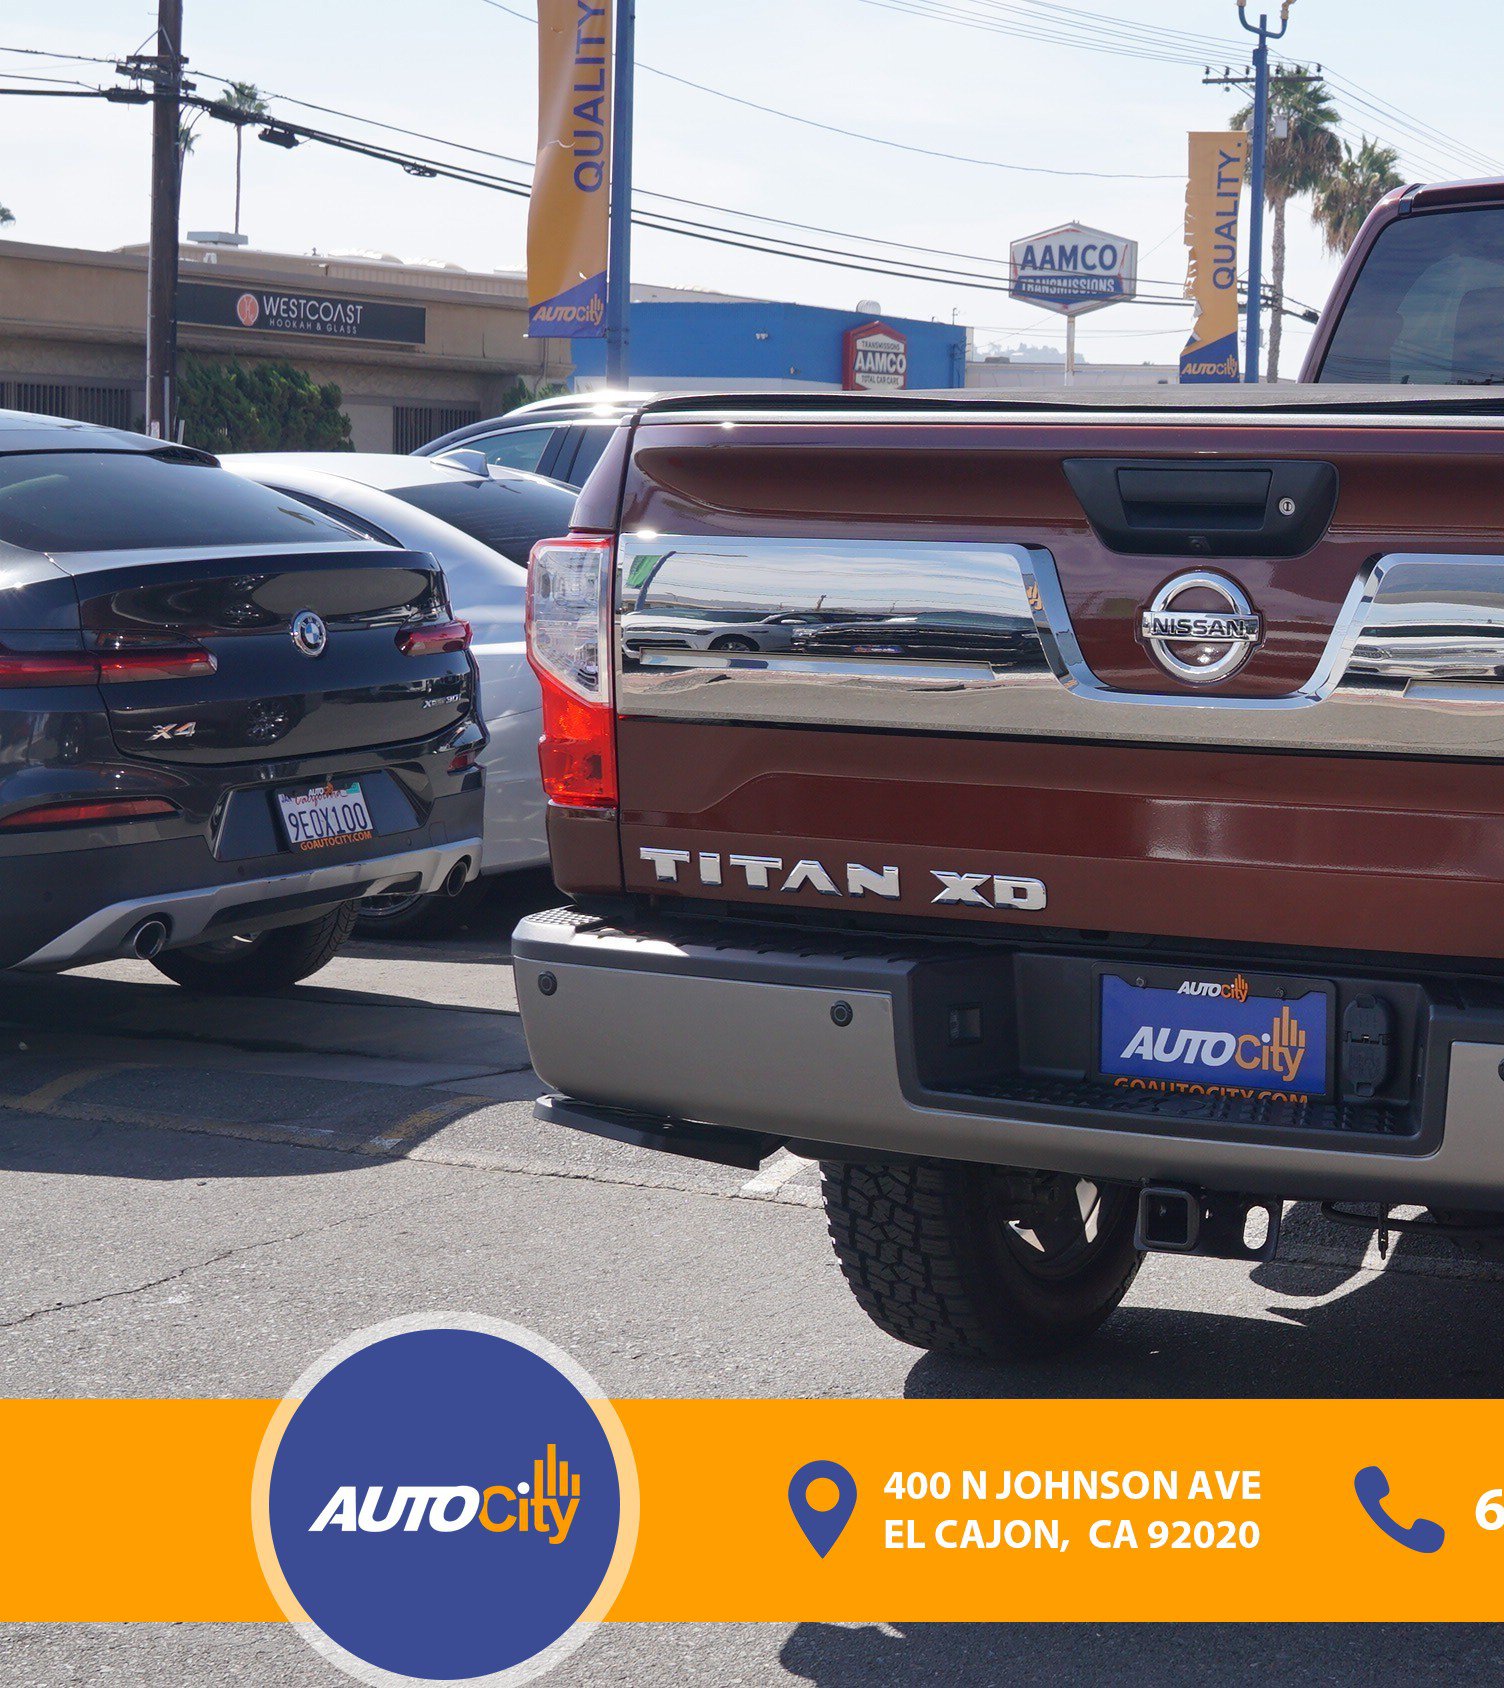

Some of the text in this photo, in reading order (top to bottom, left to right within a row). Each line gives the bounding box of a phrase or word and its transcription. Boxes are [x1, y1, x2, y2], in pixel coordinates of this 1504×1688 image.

[573, 0, 605, 193] QUALITY
[1020, 244, 1117, 271] AAMCO
[1020, 278, 1115, 295] TRANSMISSIONS
[263, 295, 363, 324] WESTCOAST
[269, 318, 358, 335] HOOKAH & GLASS
[854, 351, 907, 374] AAMCO
[1152, 617, 1245, 636] NISSAN
[145, 722, 197, 741] X4
[300, 831, 372, 851] GOAUTOCITY.COM
[639, 847, 1047, 910] TITAN XD
